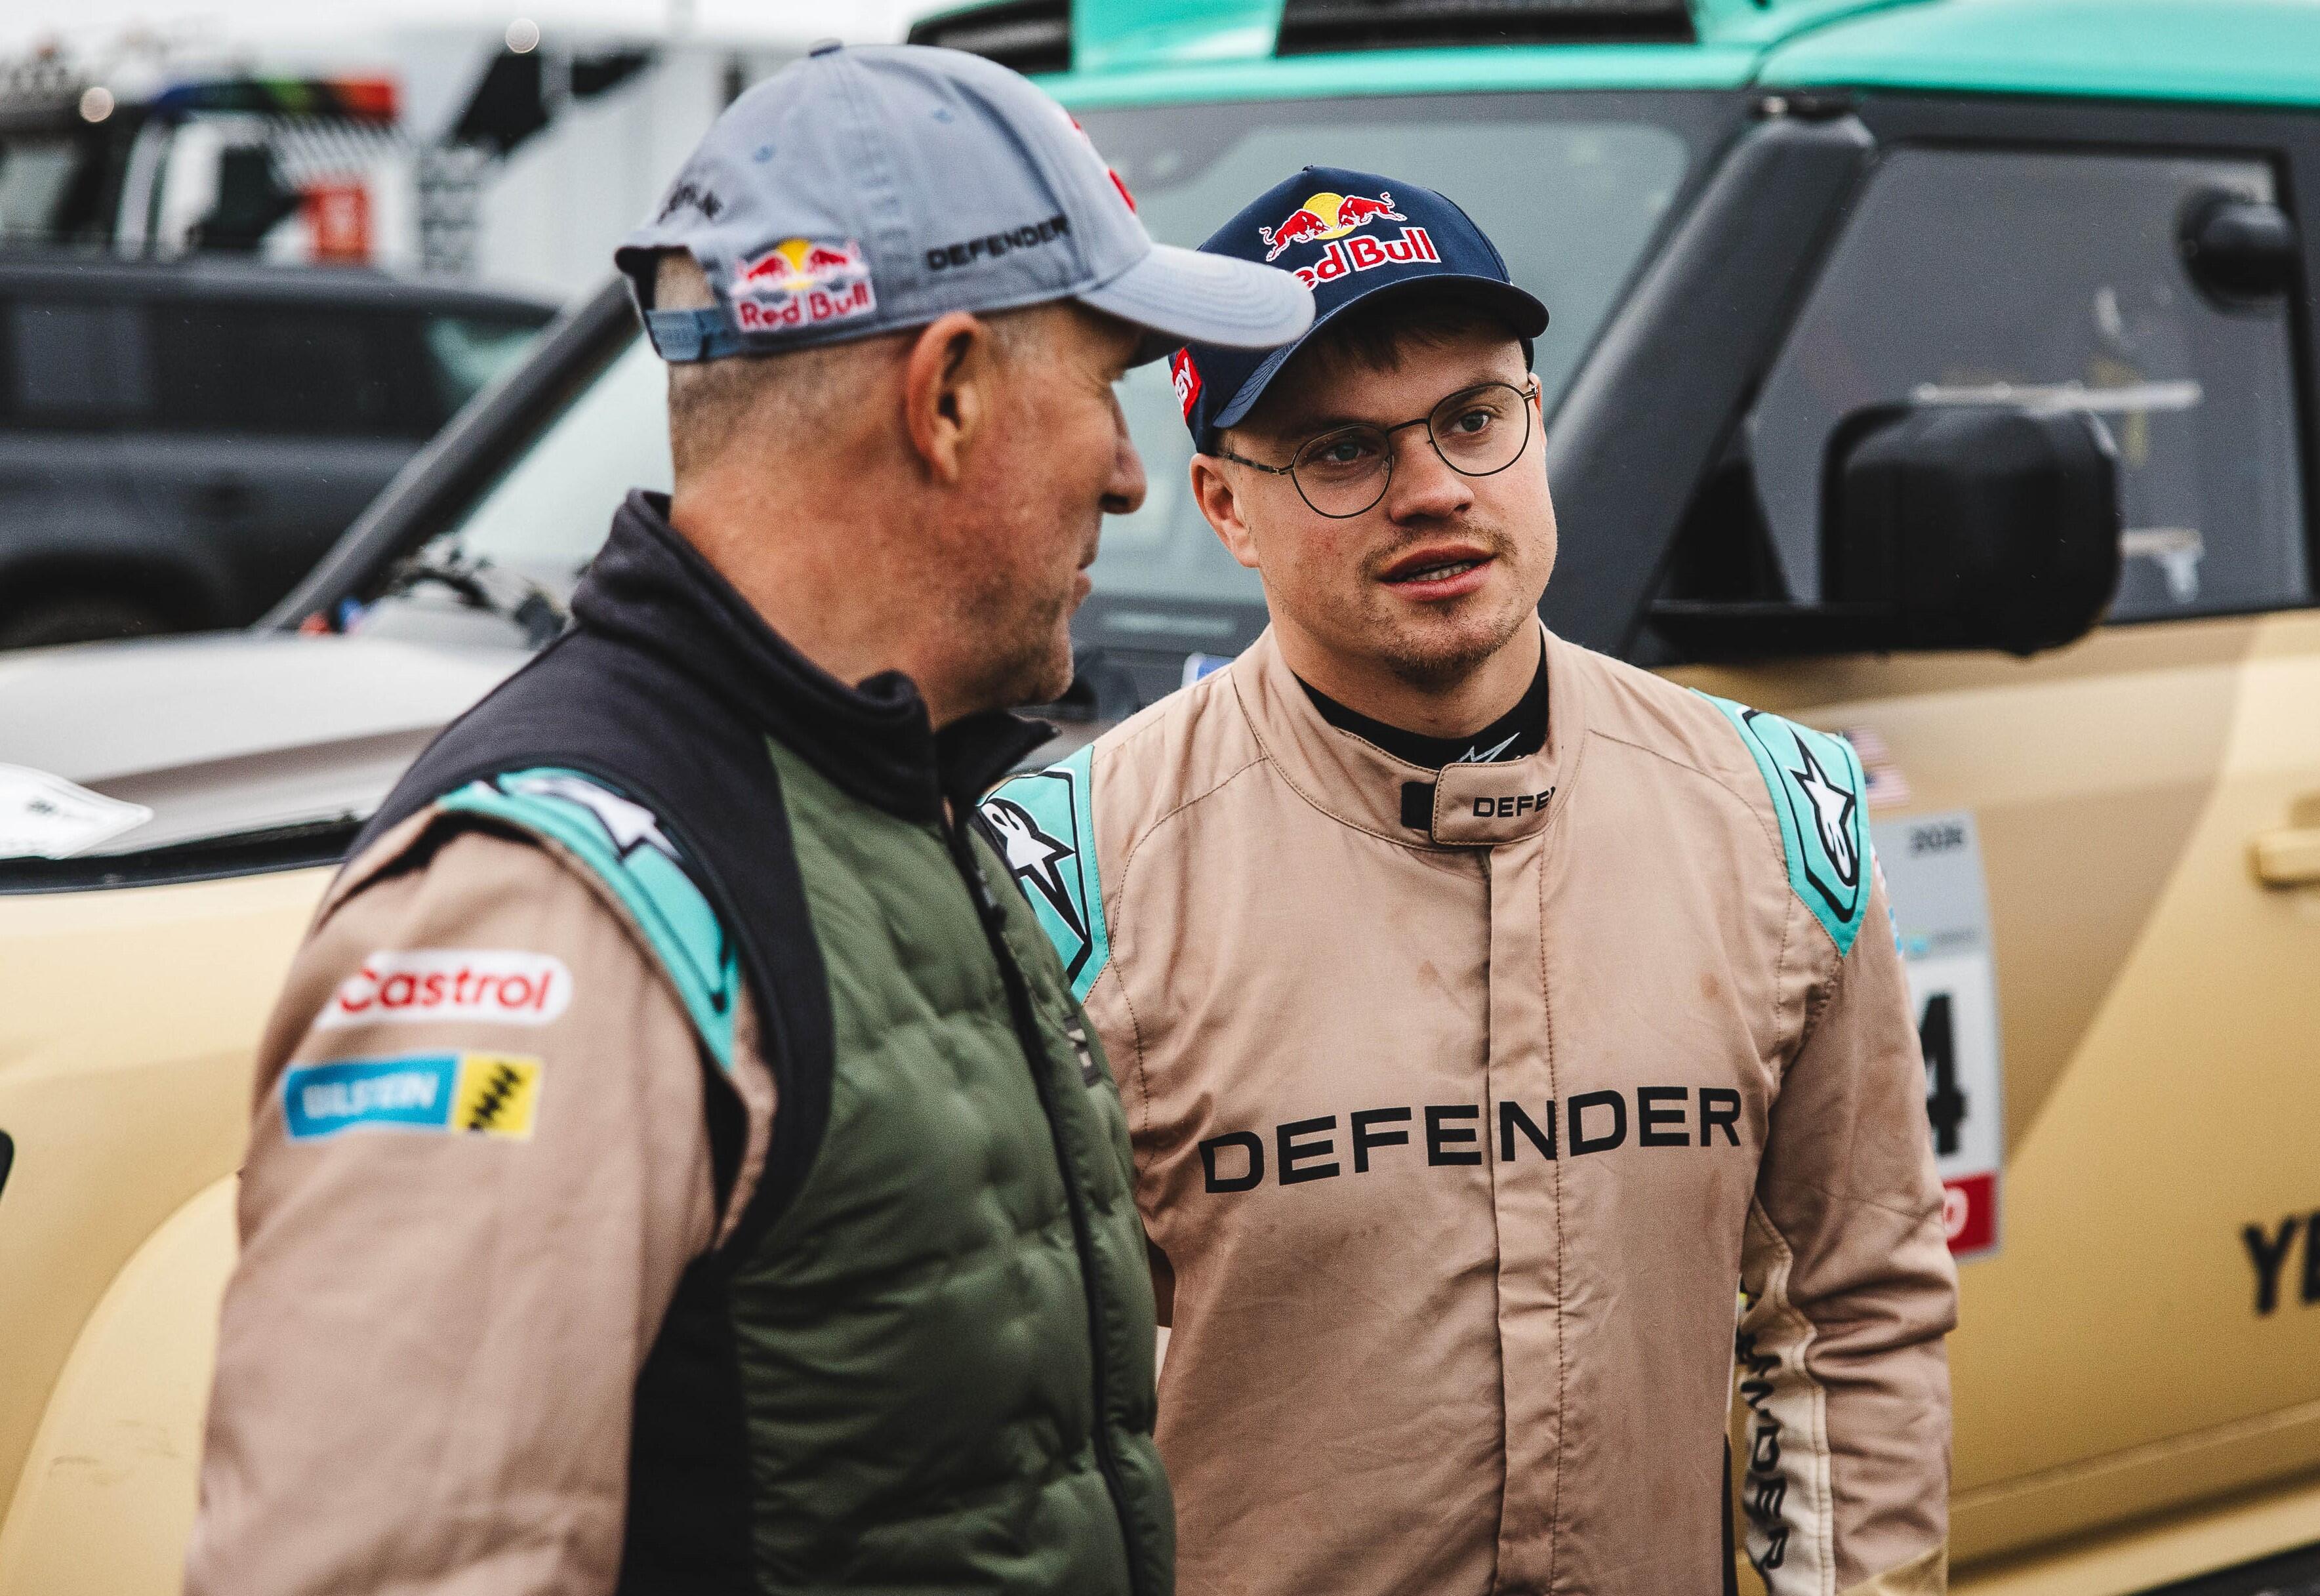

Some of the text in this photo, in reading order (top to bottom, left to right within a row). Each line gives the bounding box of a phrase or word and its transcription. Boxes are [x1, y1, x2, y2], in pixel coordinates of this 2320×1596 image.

[1295, 228, 1437, 289] ed Bull
[740, 281, 868, 327] Red Bull
[1473, 786, 1557, 818] DEFE
[1198, 1086, 1742, 1194] DEFENDER
